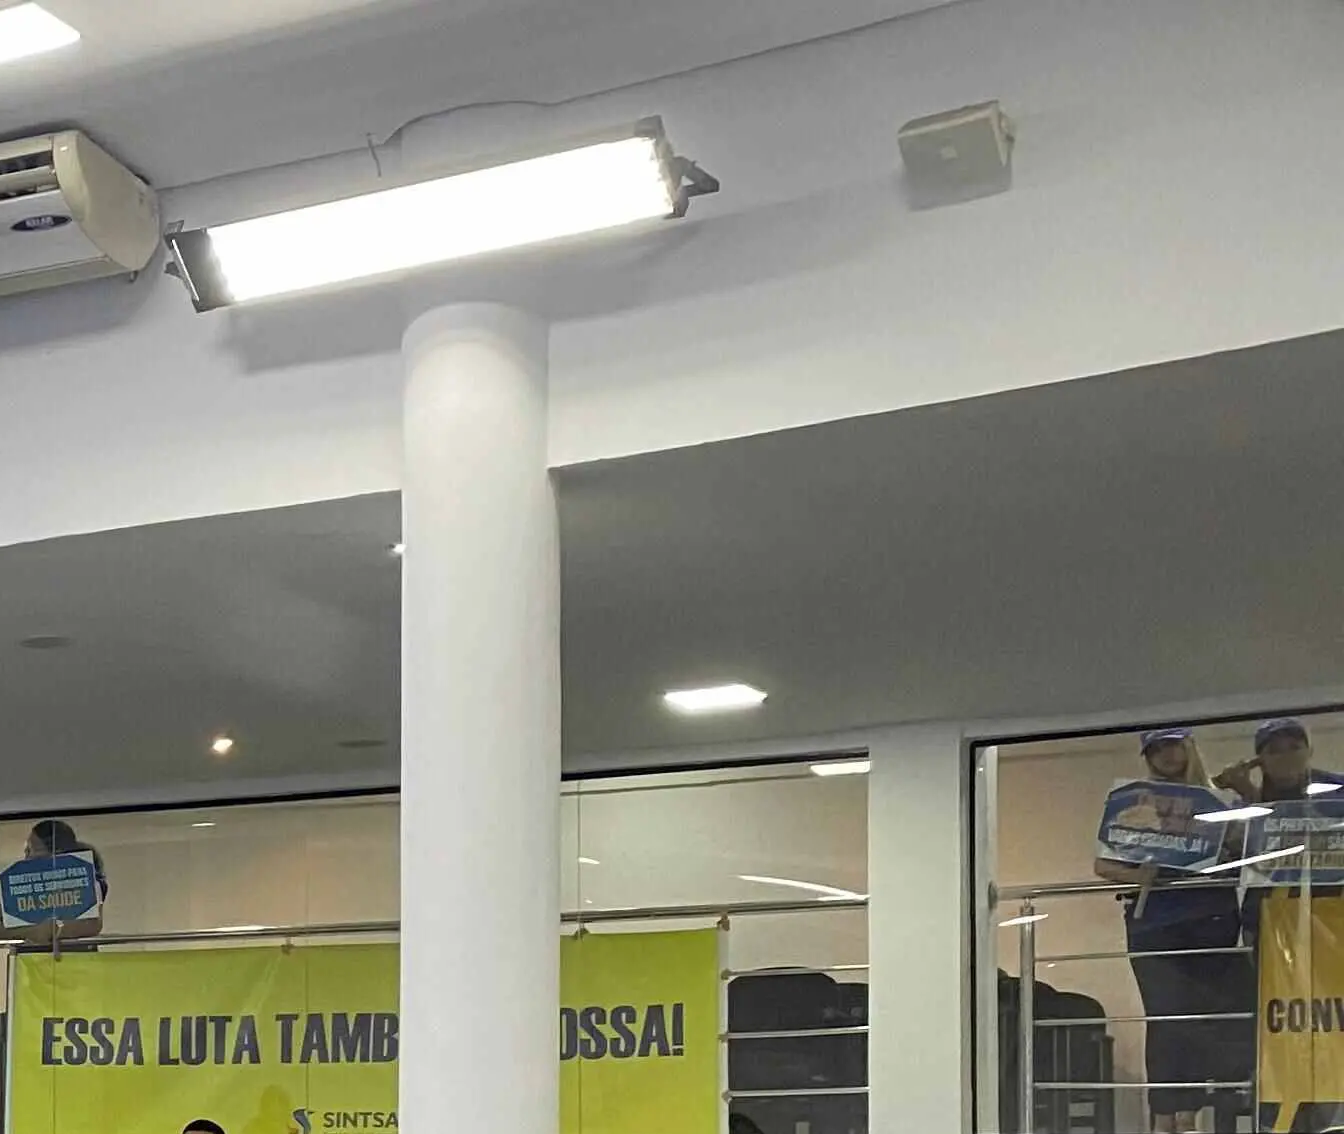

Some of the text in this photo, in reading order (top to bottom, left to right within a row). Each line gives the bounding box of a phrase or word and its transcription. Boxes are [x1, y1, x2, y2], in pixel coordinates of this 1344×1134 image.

[17, 897, 37, 912] DA
[41, 1017, 144, 1066] ESSA
[158, 1014, 261, 1066] LUTA
[275, 1012, 399, 1065] TAMB
